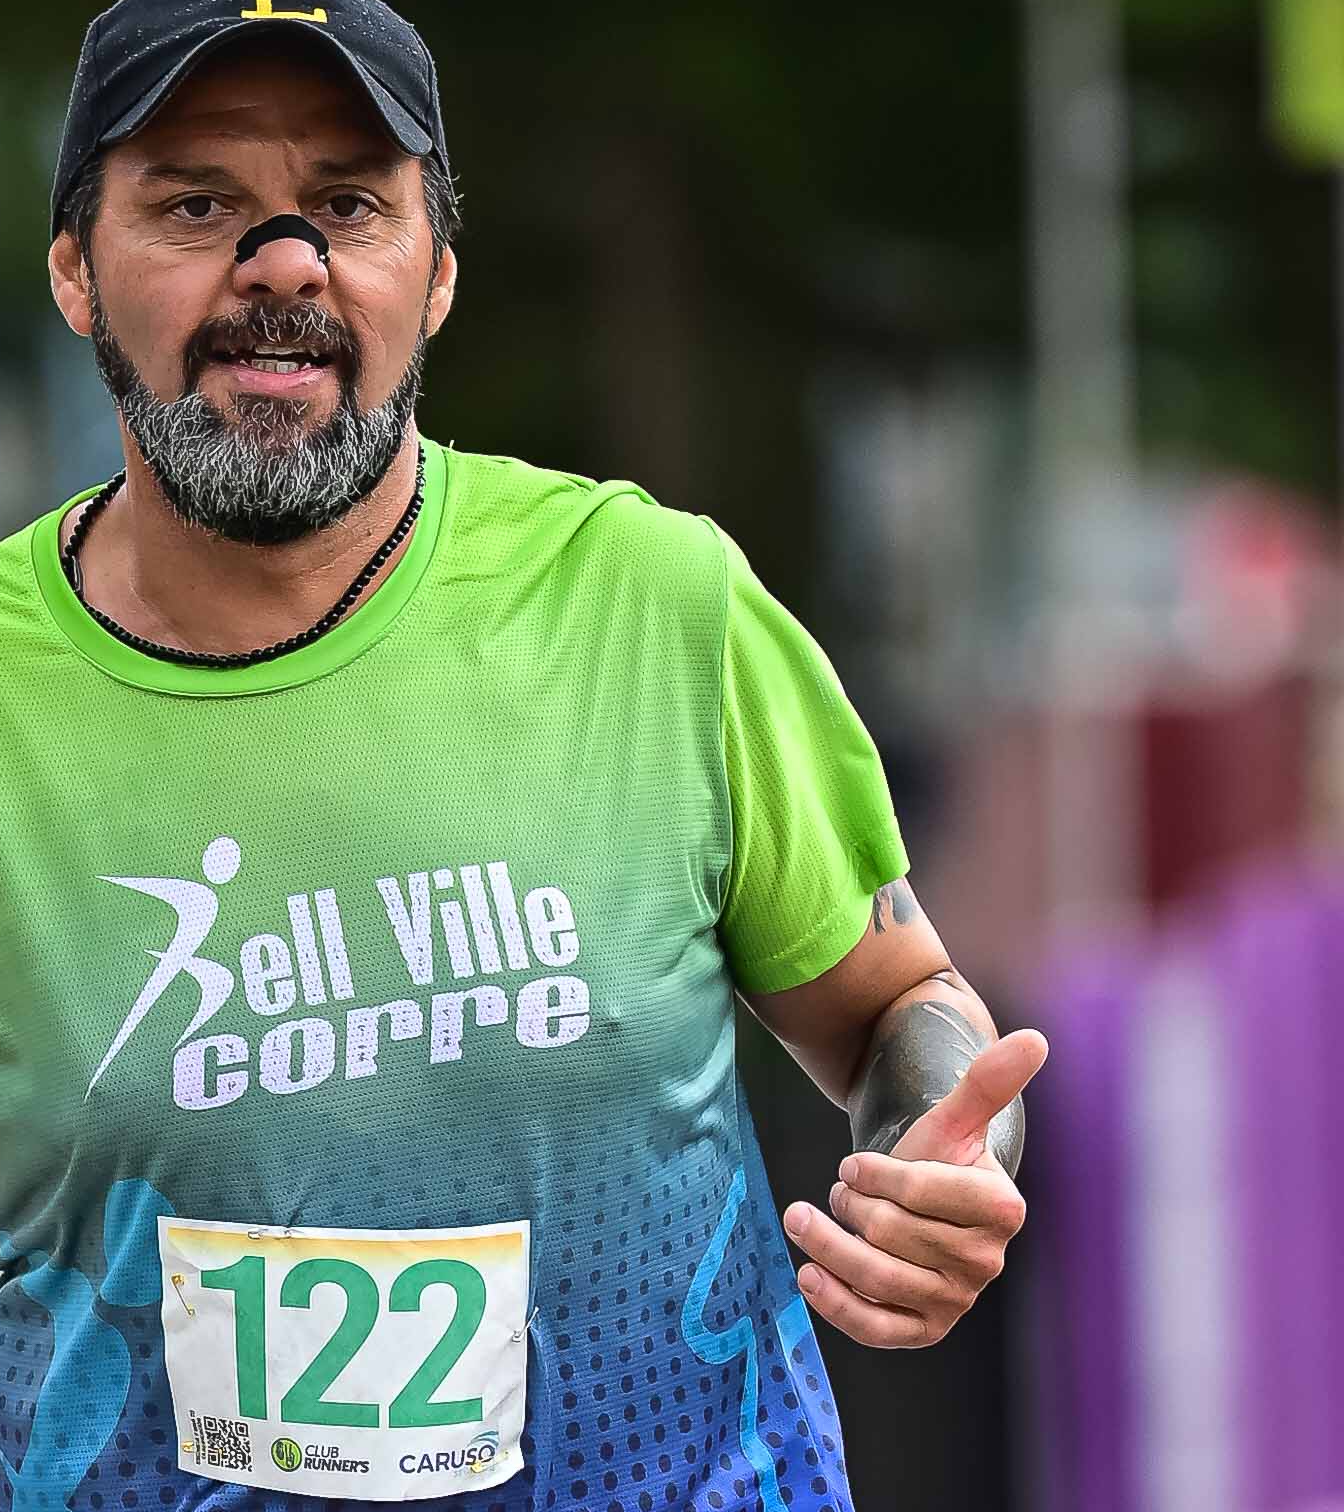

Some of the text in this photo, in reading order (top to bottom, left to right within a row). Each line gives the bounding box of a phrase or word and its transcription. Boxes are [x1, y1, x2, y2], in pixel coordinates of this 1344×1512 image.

[376, 861, 580, 985] Ville
[172, 975, 591, 1111] corre
[200, 1255, 487, 1429] 122
[304, 1445, 339, 1459] CLUB
[399, 1445, 496, 1474] CARUSO
